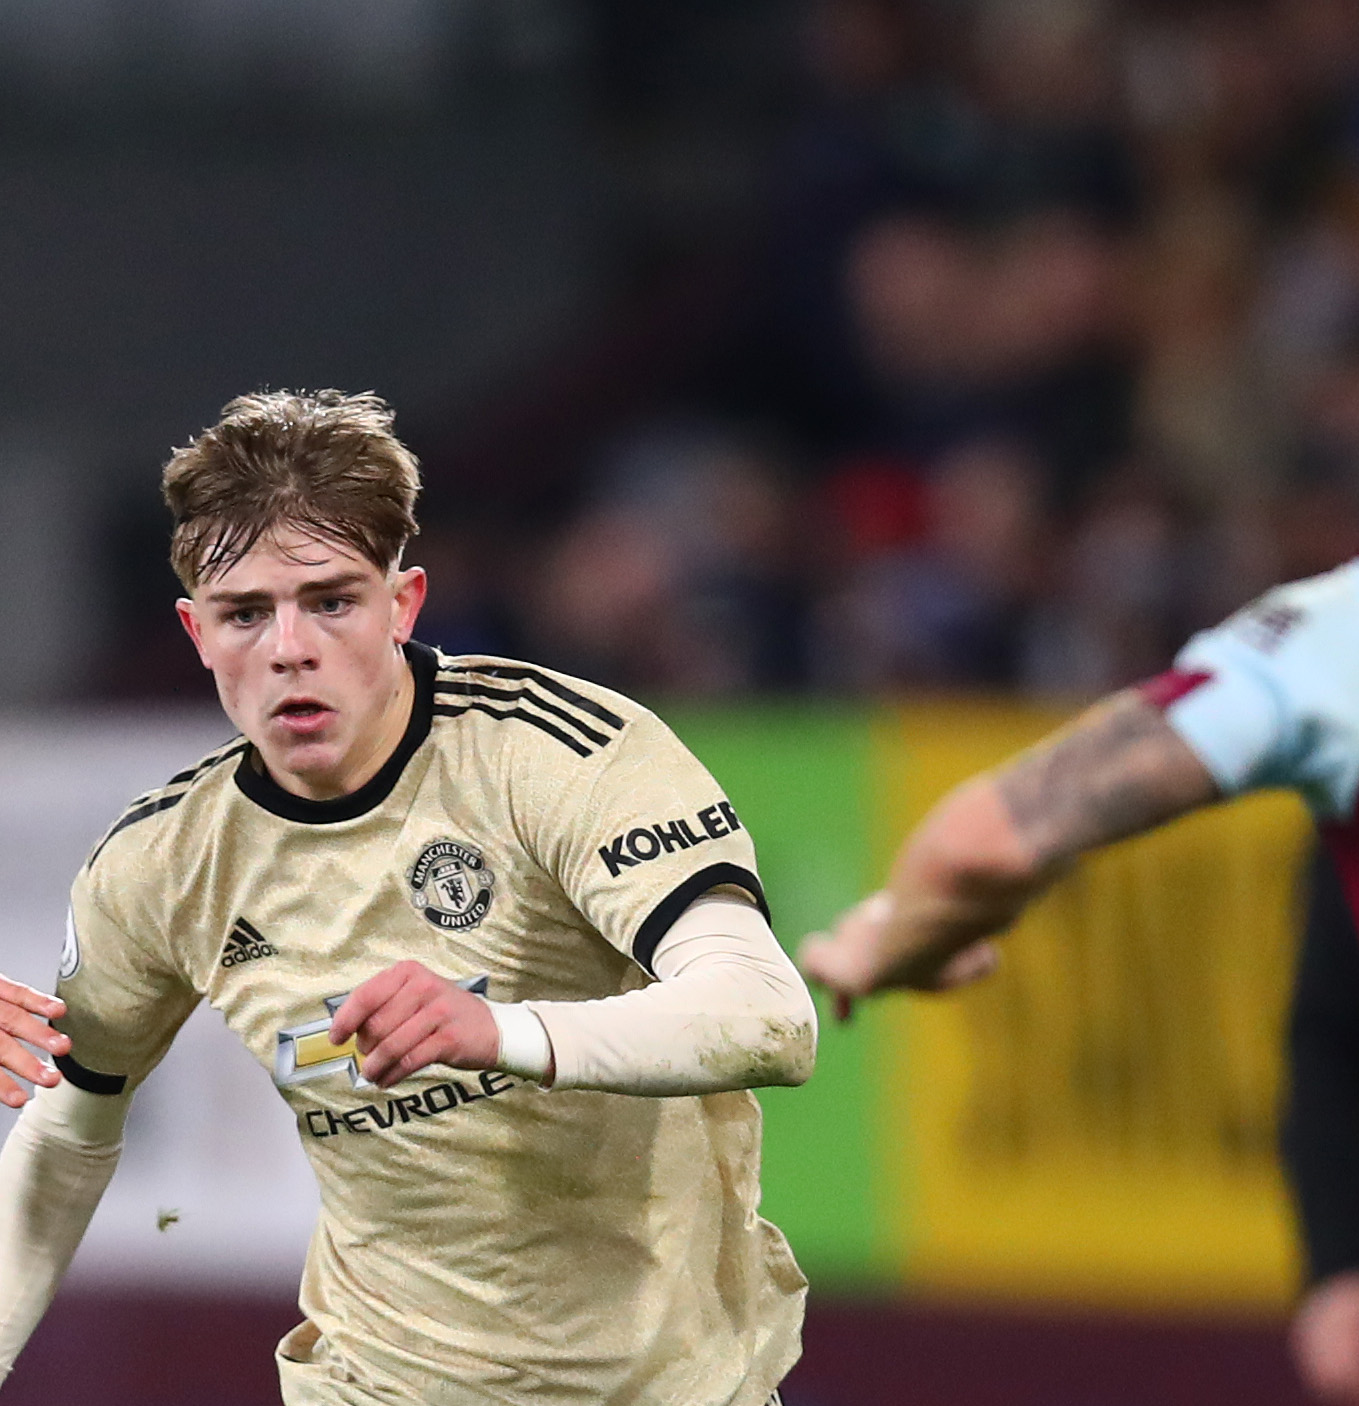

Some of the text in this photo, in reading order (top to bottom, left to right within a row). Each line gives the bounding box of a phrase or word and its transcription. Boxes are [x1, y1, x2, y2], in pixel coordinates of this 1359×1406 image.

[414, 843, 485, 927] MANCHESTER UNITED
[305, 1069, 515, 1137] CHEVROLE
